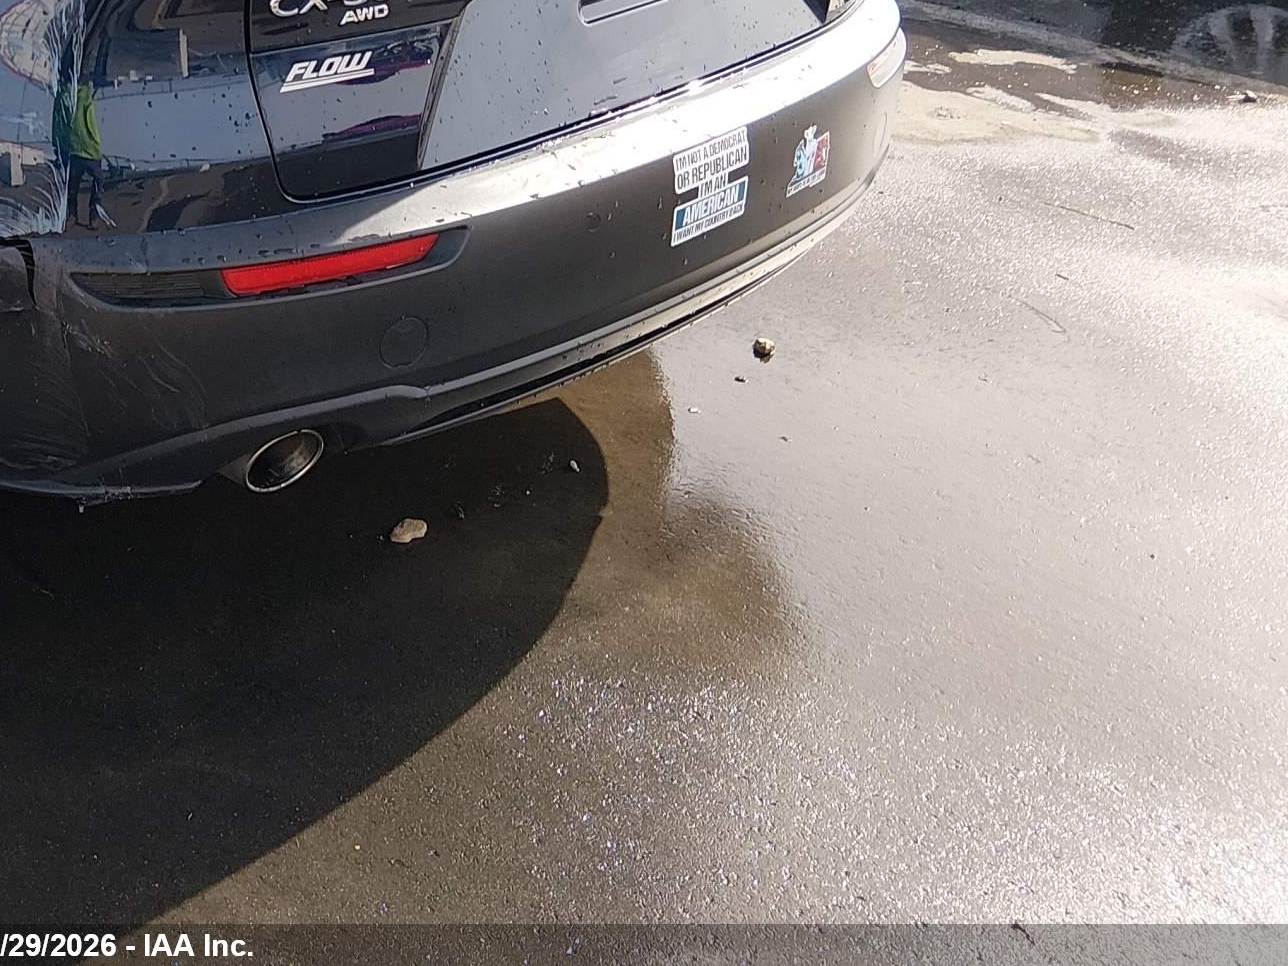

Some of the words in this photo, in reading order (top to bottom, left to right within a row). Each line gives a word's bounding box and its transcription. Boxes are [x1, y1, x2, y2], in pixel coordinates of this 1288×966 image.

[339, 3, 390, 26] AWD
[284, 50, 373, 83] FLOW
[709, 129, 746, 156] DEMOCRAT
[677, 170, 690, 190] OR
[692, 145, 747, 185] REPUBLICAN
[714, 173, 727, 190] AN
[682, 184, 740, 227] AMERICAN
